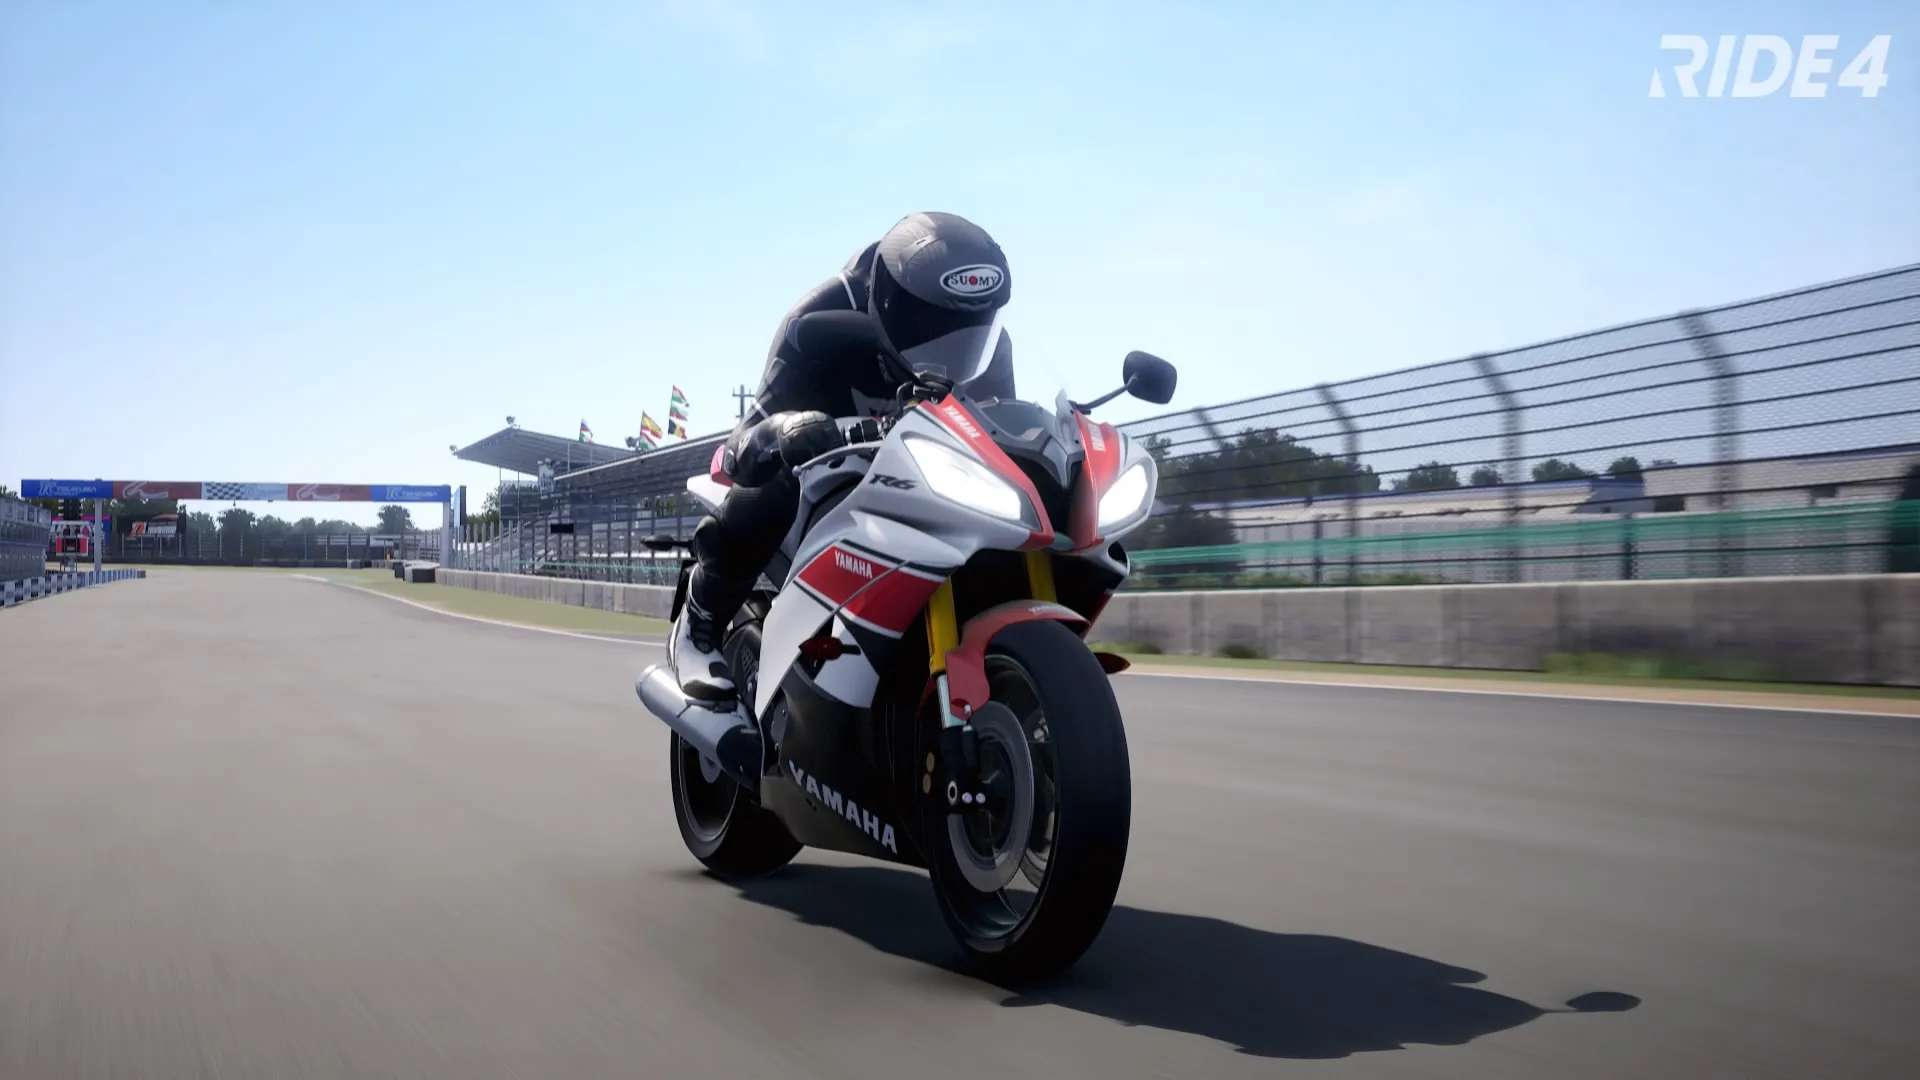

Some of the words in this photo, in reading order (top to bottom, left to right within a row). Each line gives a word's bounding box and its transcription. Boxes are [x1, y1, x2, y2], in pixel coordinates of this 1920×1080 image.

[950, 274, 998, 286] SUOMY
[943, 405, 981, 438] YAMAHA
[868, 473, 917, 491] R6
[835, 549, 873, 579] YAMAHA
[789, 759, 897, 854] YAMAHA
